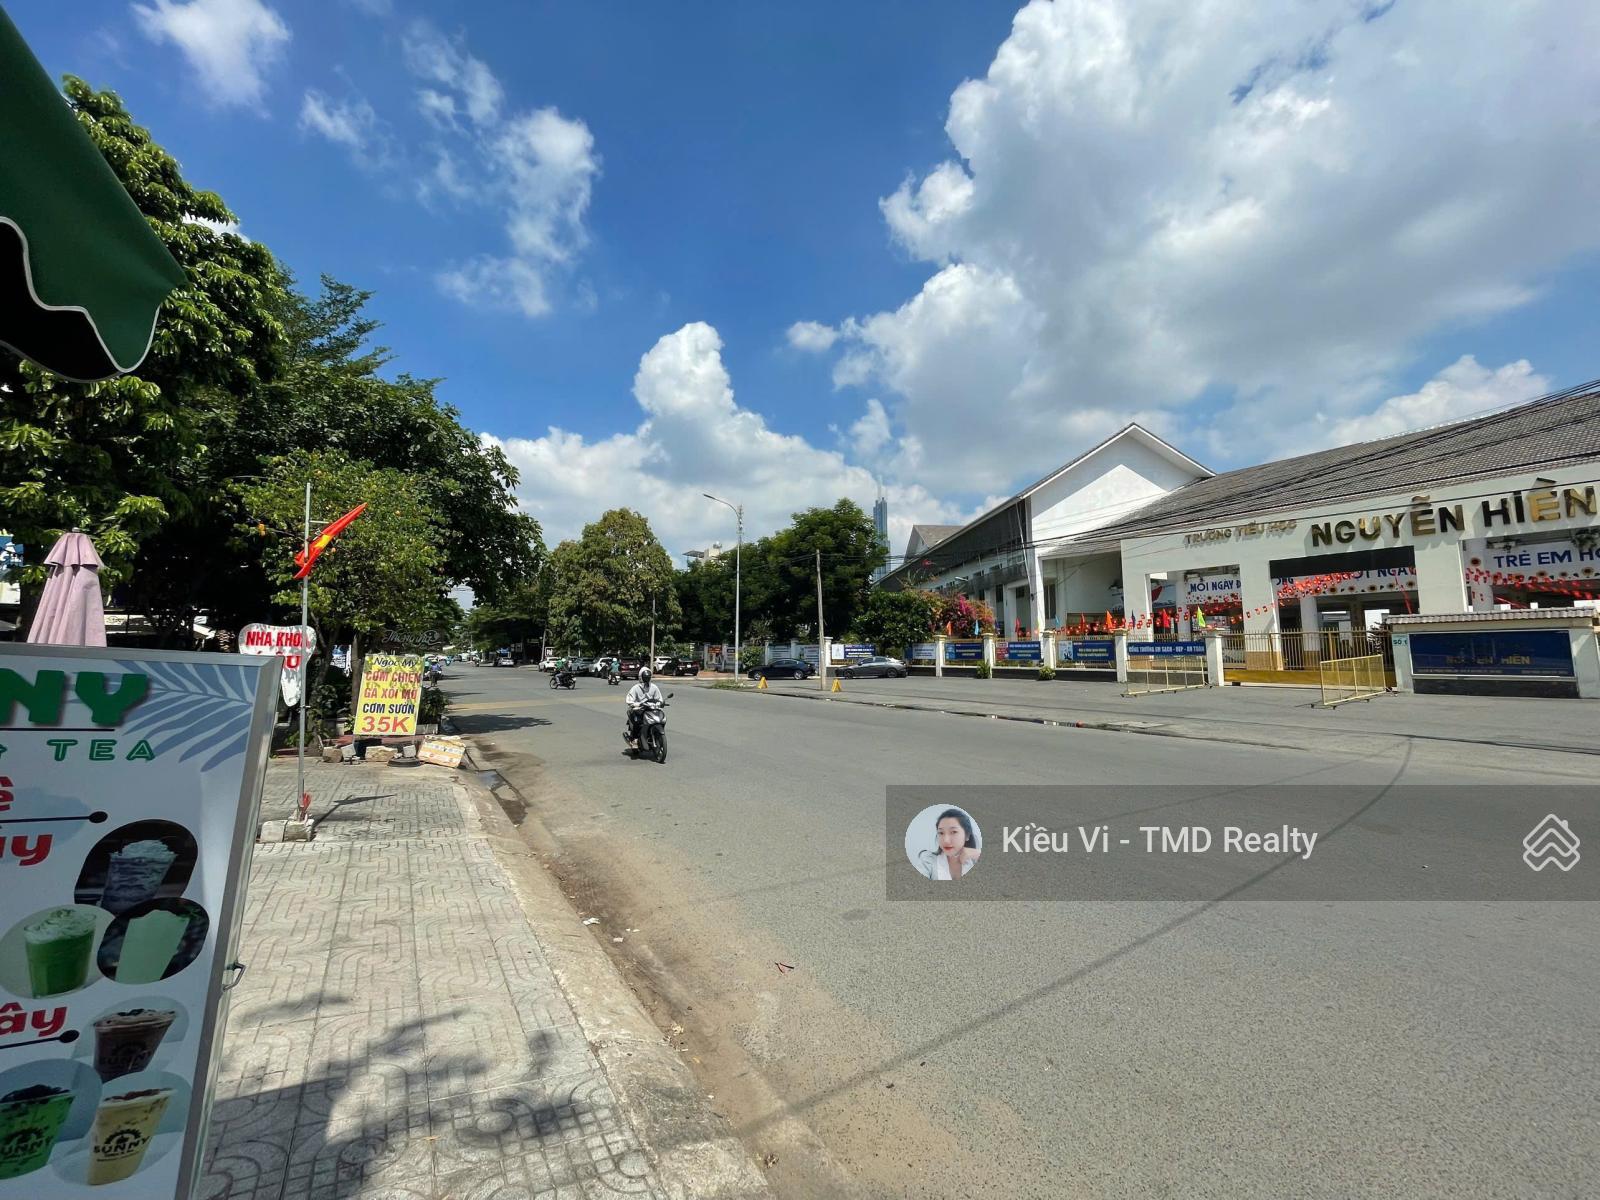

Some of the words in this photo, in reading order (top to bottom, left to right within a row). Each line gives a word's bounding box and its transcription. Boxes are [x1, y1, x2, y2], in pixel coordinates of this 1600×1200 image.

[1311, 494, 1465, 547] NGUYỄN
[1481, 477, 1598, 528] HIỀN
[1537, 549, 1573, 565] EM
[246, 631, 272, 646] NHA
[363, 702, 386, 714] CƠM
[361, 715, 410, 733] 35K
[46, 738, 156, 762] TEA
